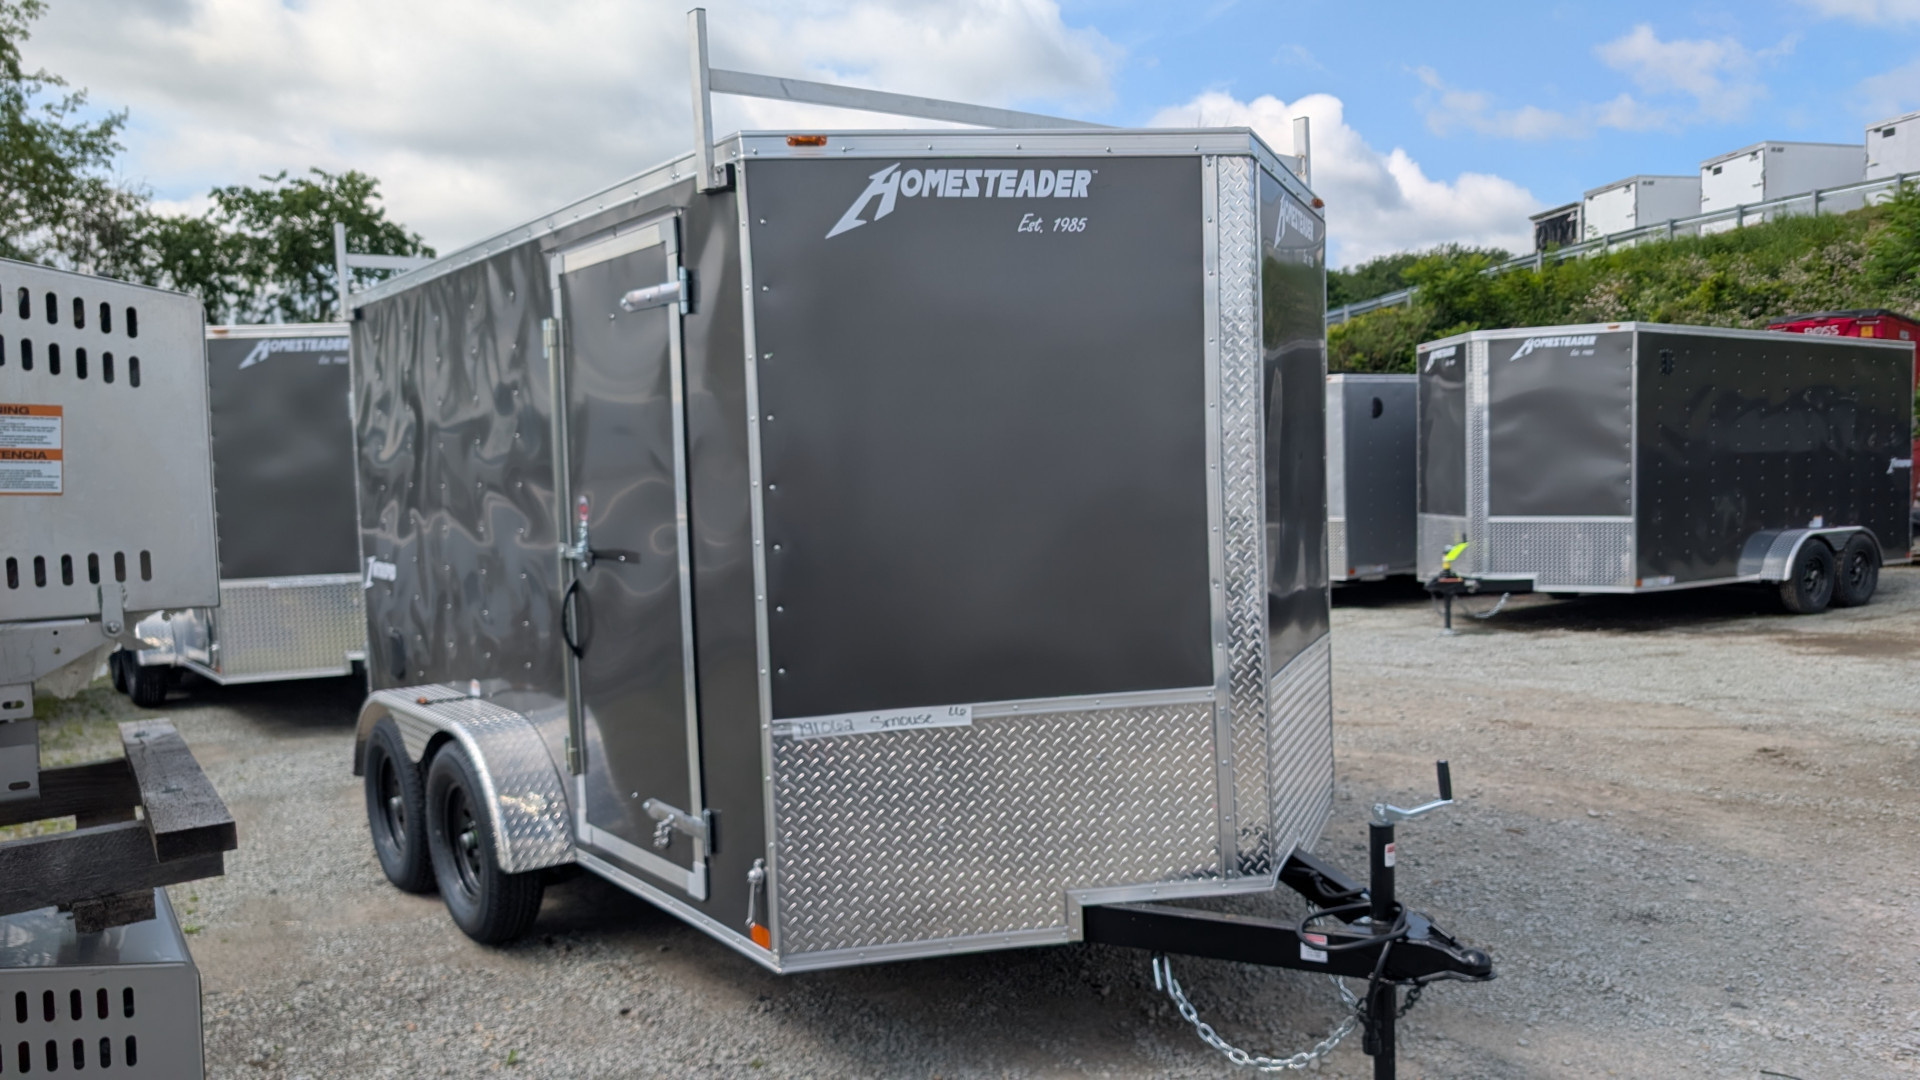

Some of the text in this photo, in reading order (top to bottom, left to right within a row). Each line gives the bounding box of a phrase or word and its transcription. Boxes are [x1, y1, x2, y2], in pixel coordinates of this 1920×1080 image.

[825, 162, 1092, 239] HOMESTEADER
[1017, 213, 1088, 234] Est. 1985
